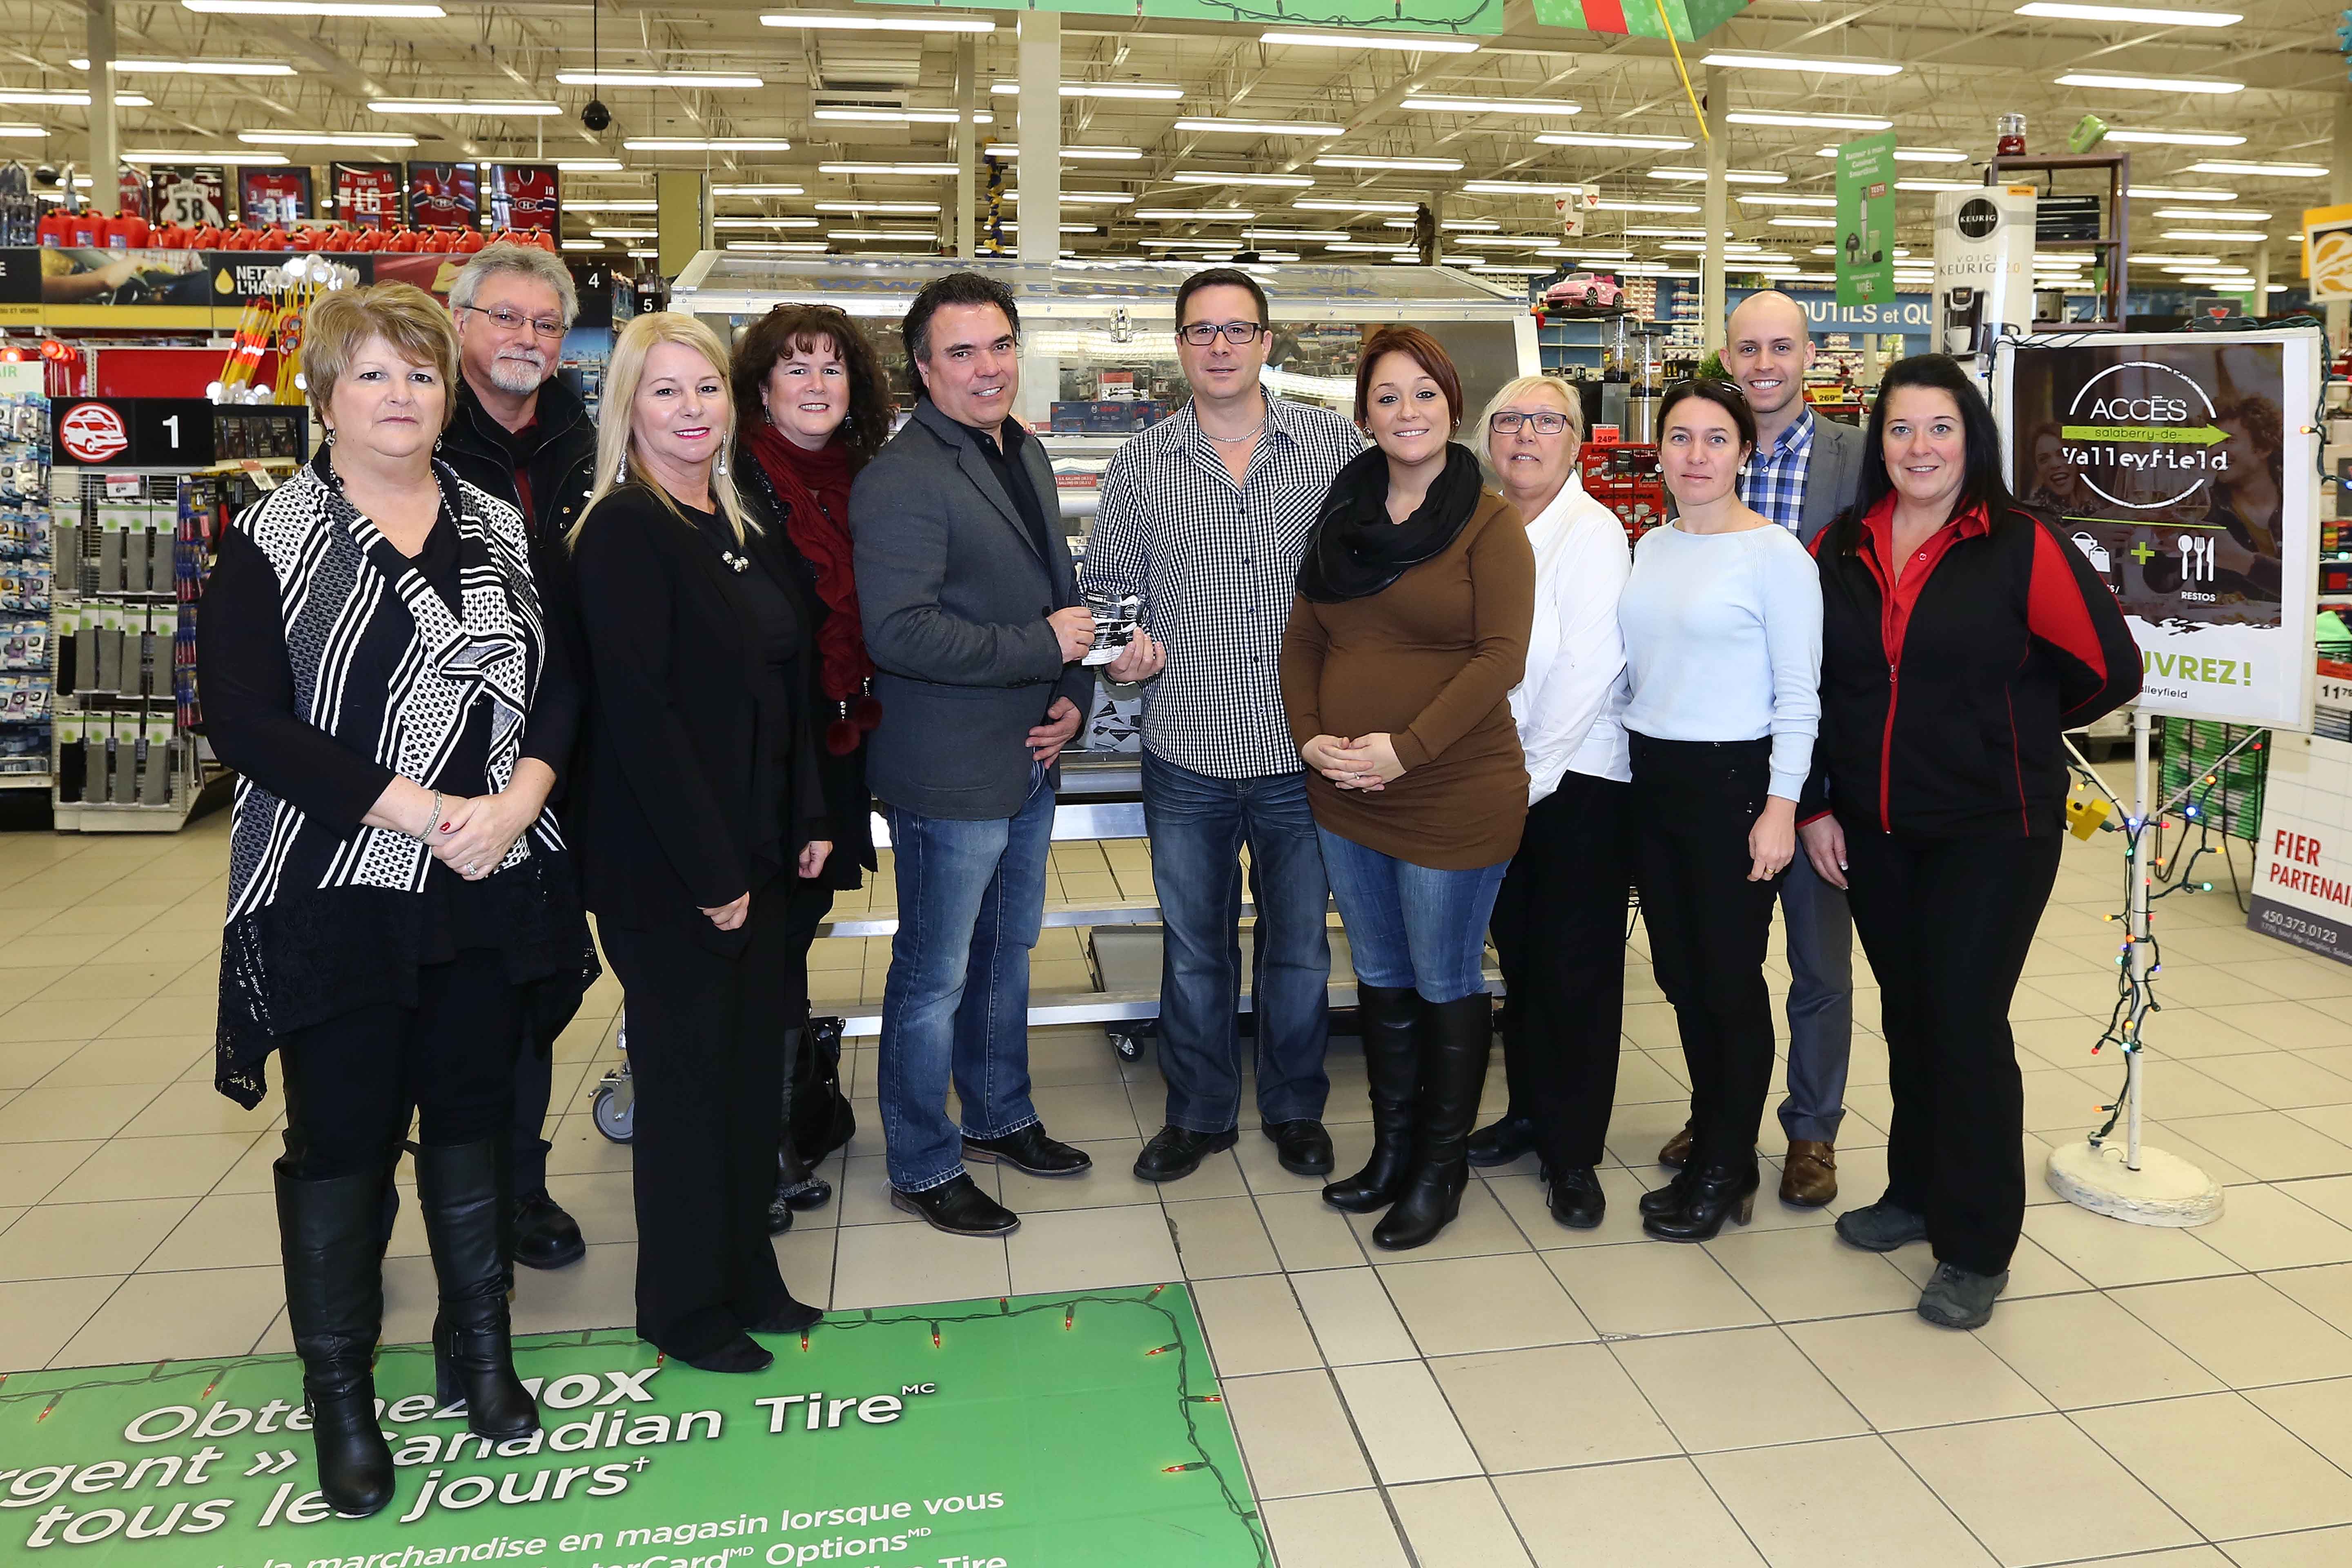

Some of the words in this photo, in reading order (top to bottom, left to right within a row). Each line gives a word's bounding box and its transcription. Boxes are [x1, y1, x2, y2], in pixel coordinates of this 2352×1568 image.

[545, 186, 555, 195] 10
[176, 198, 203, 222] 58
[1960, 214, 1996, 223] KEURIG
[588, 273, 599, 288] 4
[1940, 262, 1996, 276] KEURIG
[644, 298, 653, 312] 5
[1883, 309, 1899, 323] et
[163, 415, 179, 448] 1
[2062, 447, 2229, 471] Valleyfield
[2181, 592, 2216, 602] RESTOS
[2275, 829, 2322, 866] FIER
[2270, 862, 2352, 908] PARTENAI
[2262, 910, 2337, 944] 450.373.0123
[124, 1392, 470, 1443] Obtee
[382, 1409, 722, 1466] anadian
[26, 1498, 235, 1548] tous
[257, 1482, 372, 1527] le
[300, 1536, 547, 1568] marchandise
[559, 1532, 604, 1552] en
[615, 1514, 768, 1547] magasin
[781, 1501, 912, 1531] lorsque
[922, 1492, 1004, 1515] vous
